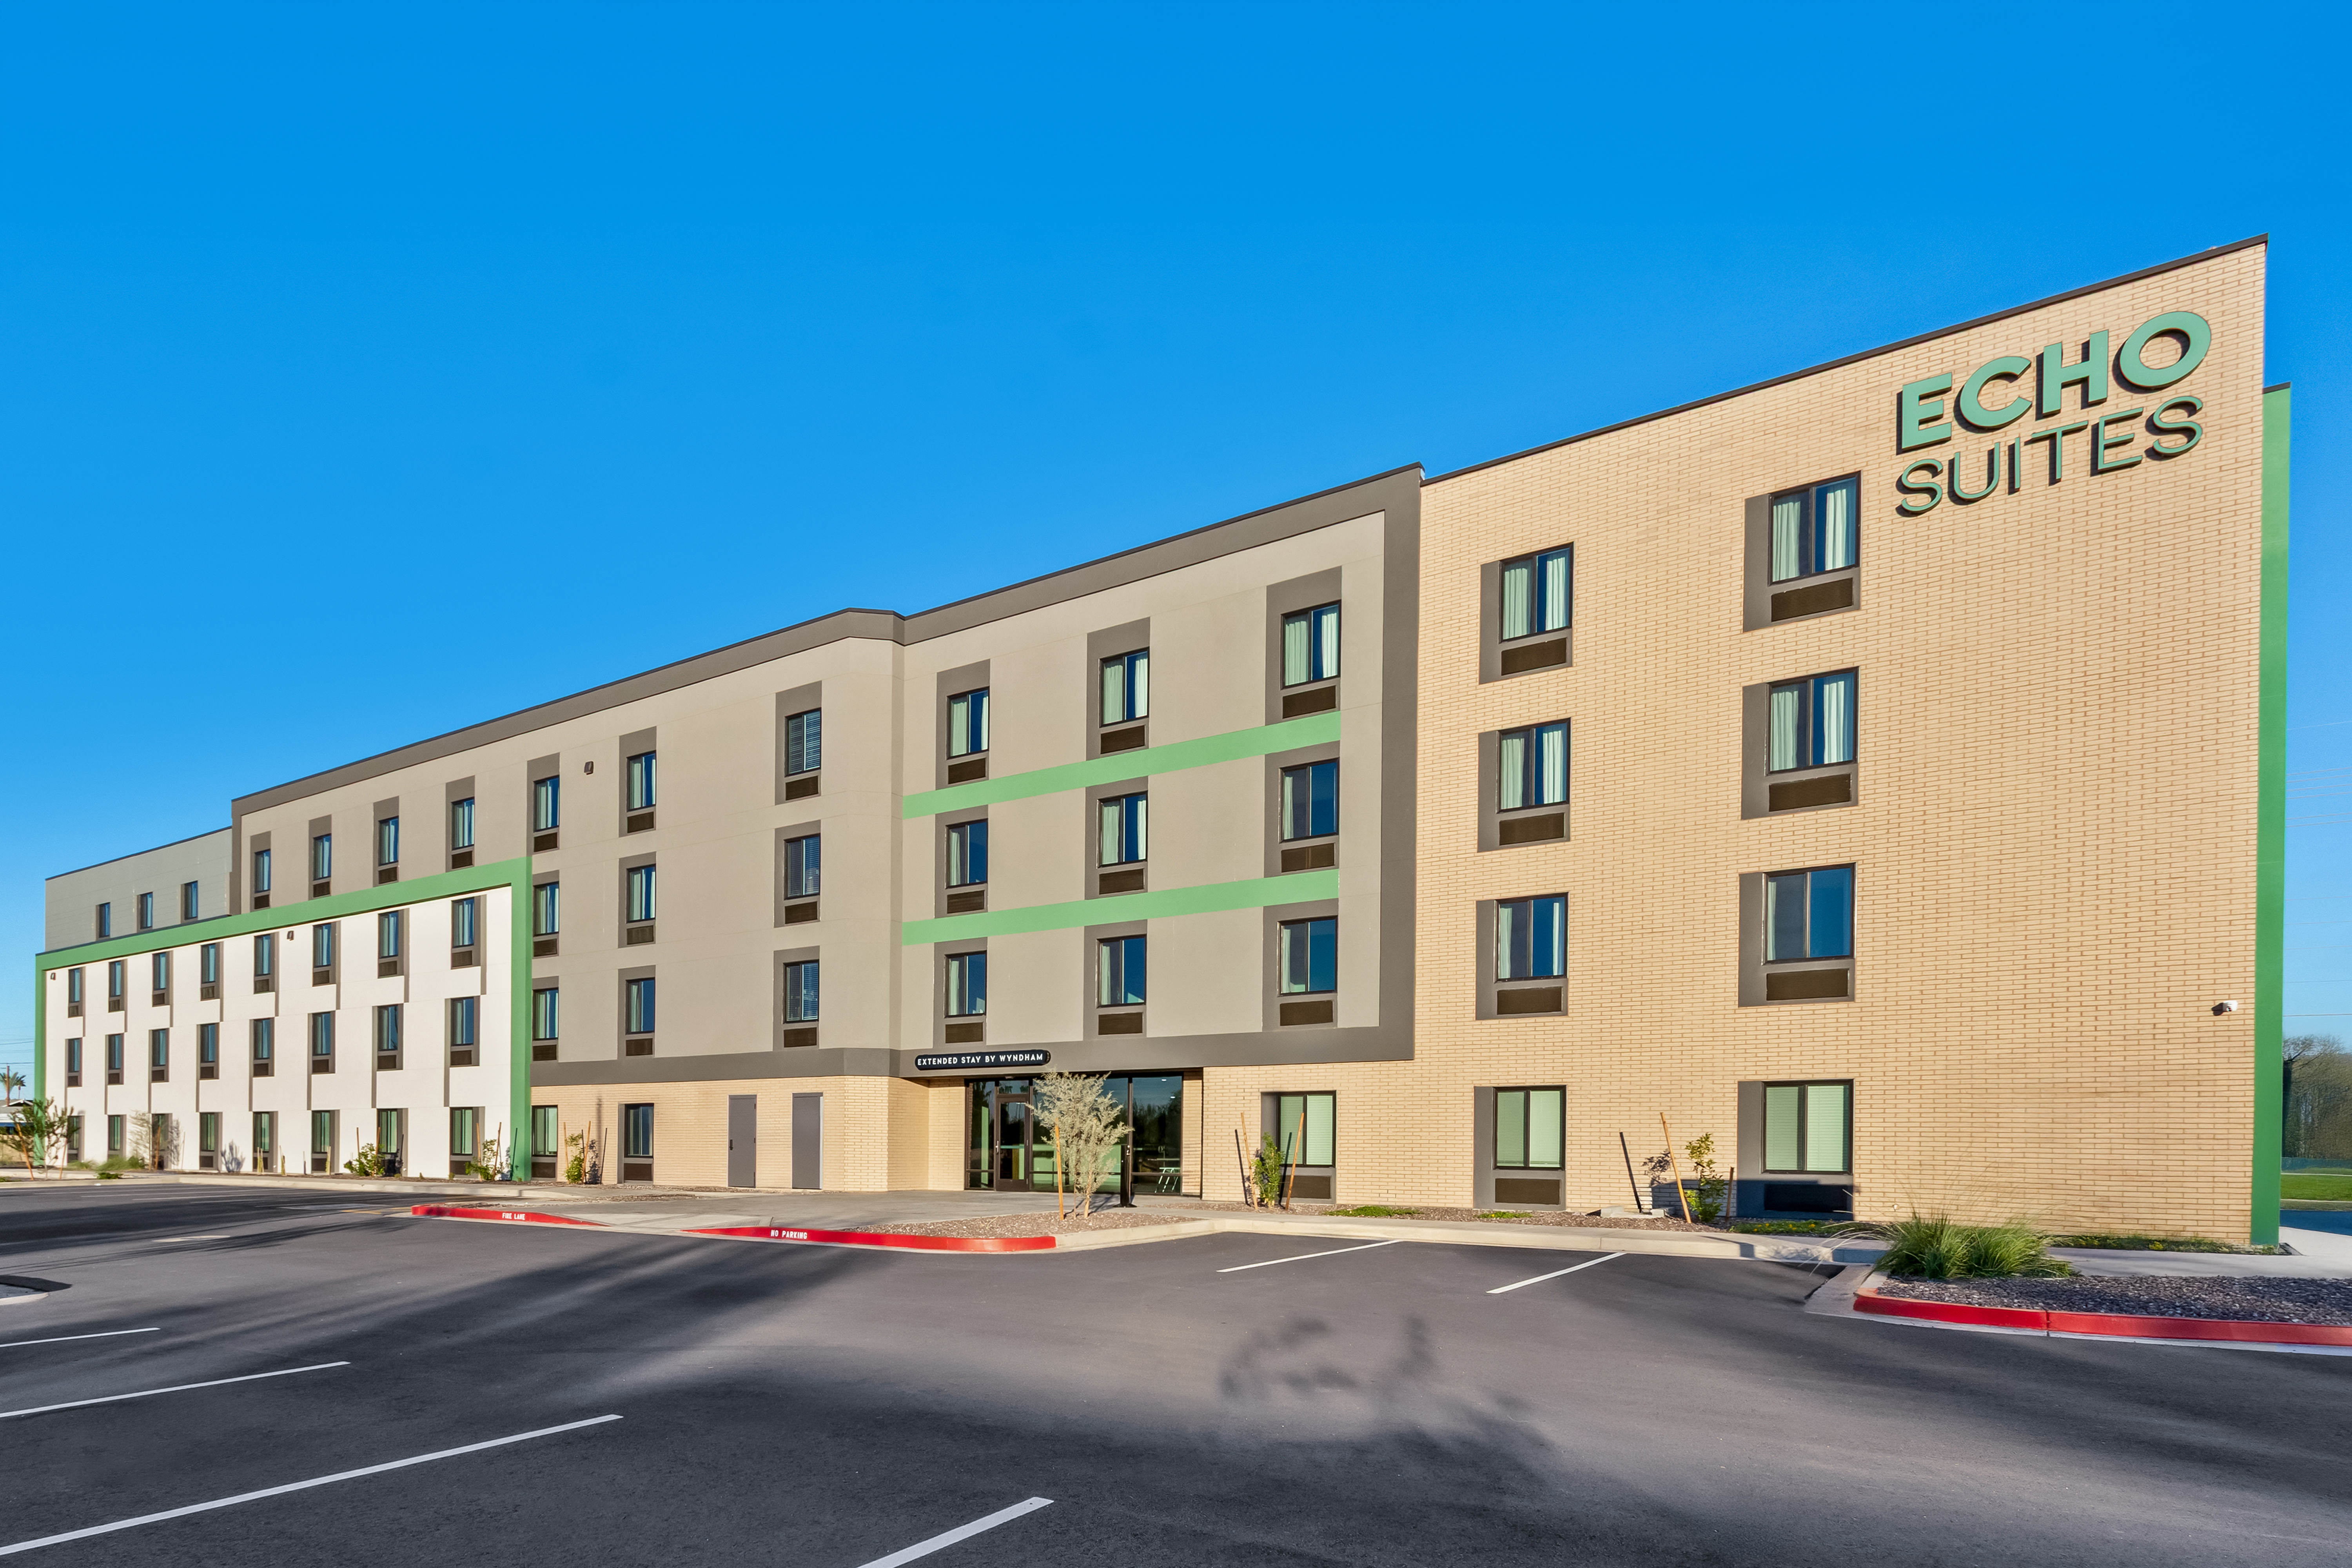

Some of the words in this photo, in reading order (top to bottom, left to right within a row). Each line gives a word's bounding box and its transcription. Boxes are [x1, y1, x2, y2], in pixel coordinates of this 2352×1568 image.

[1900, 311, 2211, 449] ECHO
[1900, 396, 2203, 513] SUITES
[918, 1057, 958, 1065] EXTENDED
[999, 1053, 1043, 1062] WYNDHAM
[782, 1230, 808, 1240] PARKING
